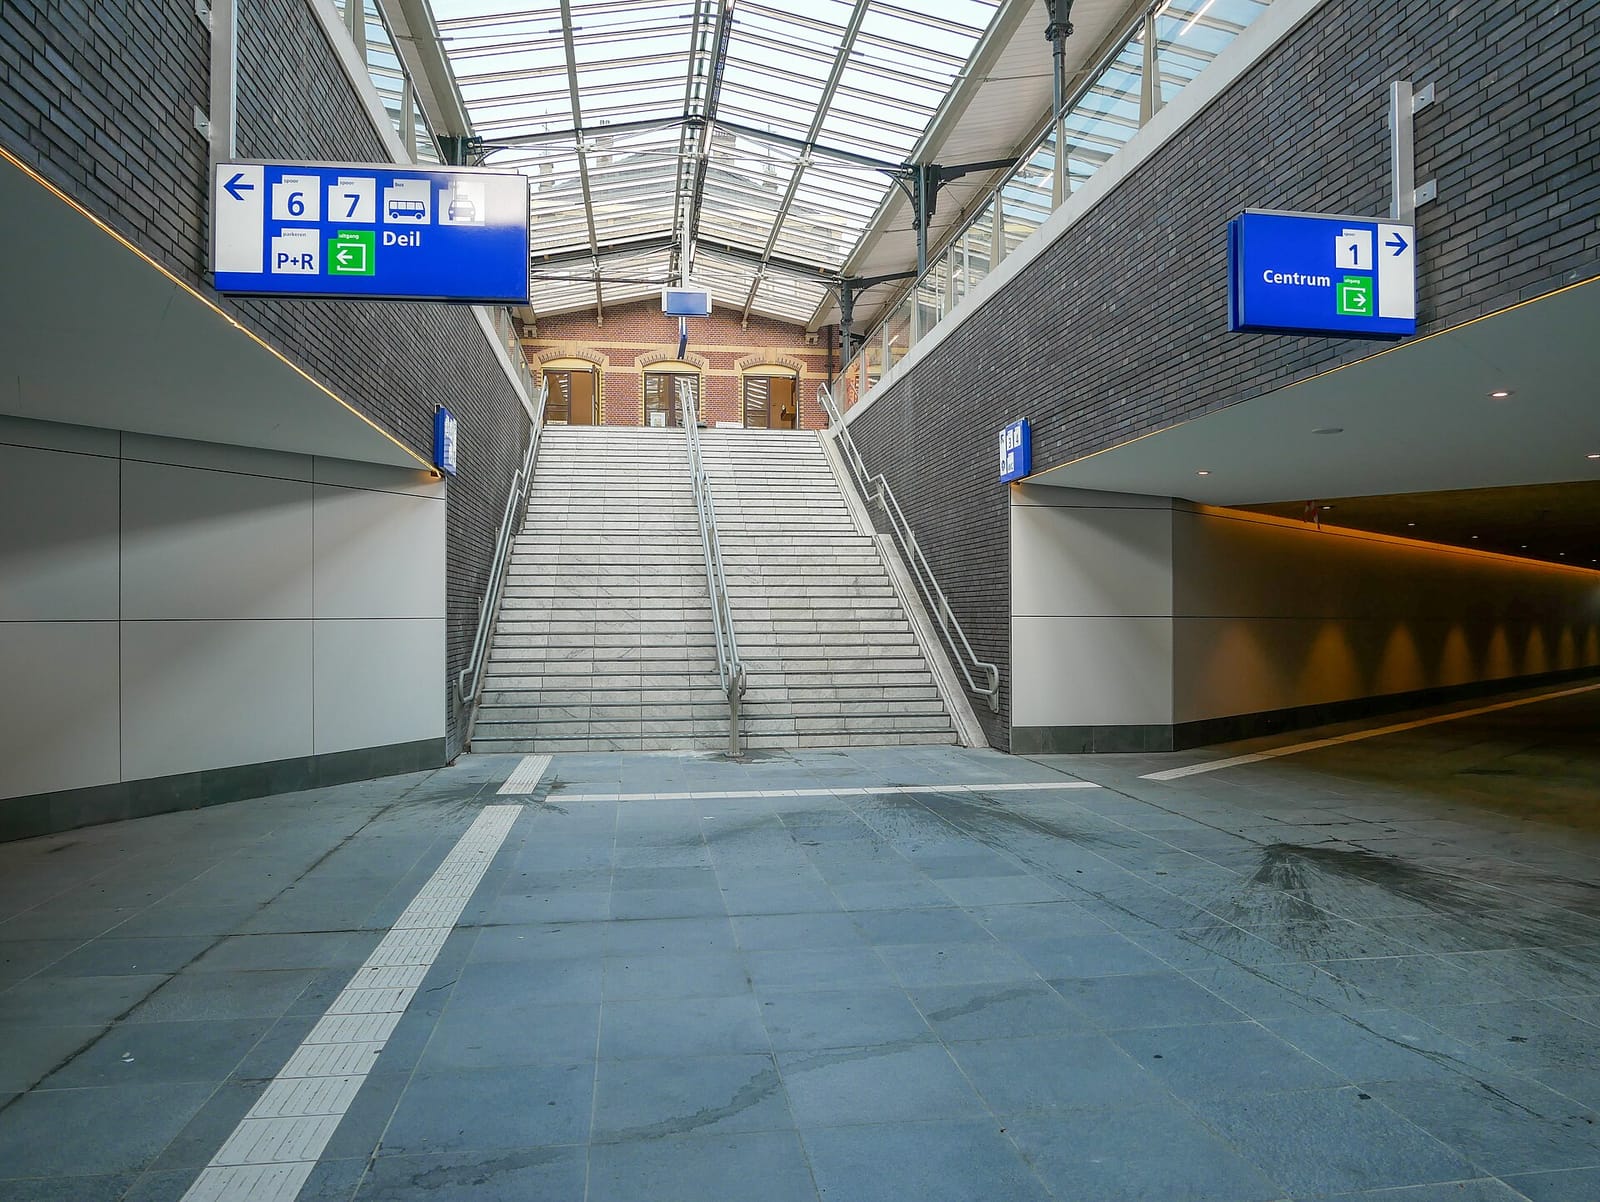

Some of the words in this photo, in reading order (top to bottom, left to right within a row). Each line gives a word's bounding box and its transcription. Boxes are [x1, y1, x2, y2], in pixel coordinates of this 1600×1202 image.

[288, 192, 304, 216] 6
[344, 194, 360, 217] 7
[383, 231, 421, 247] Deil
[277, 252, 314, 270] P+R
[1349, 244, 1358, 265] 1
[1263, 269, 1331, 287] Centrum
